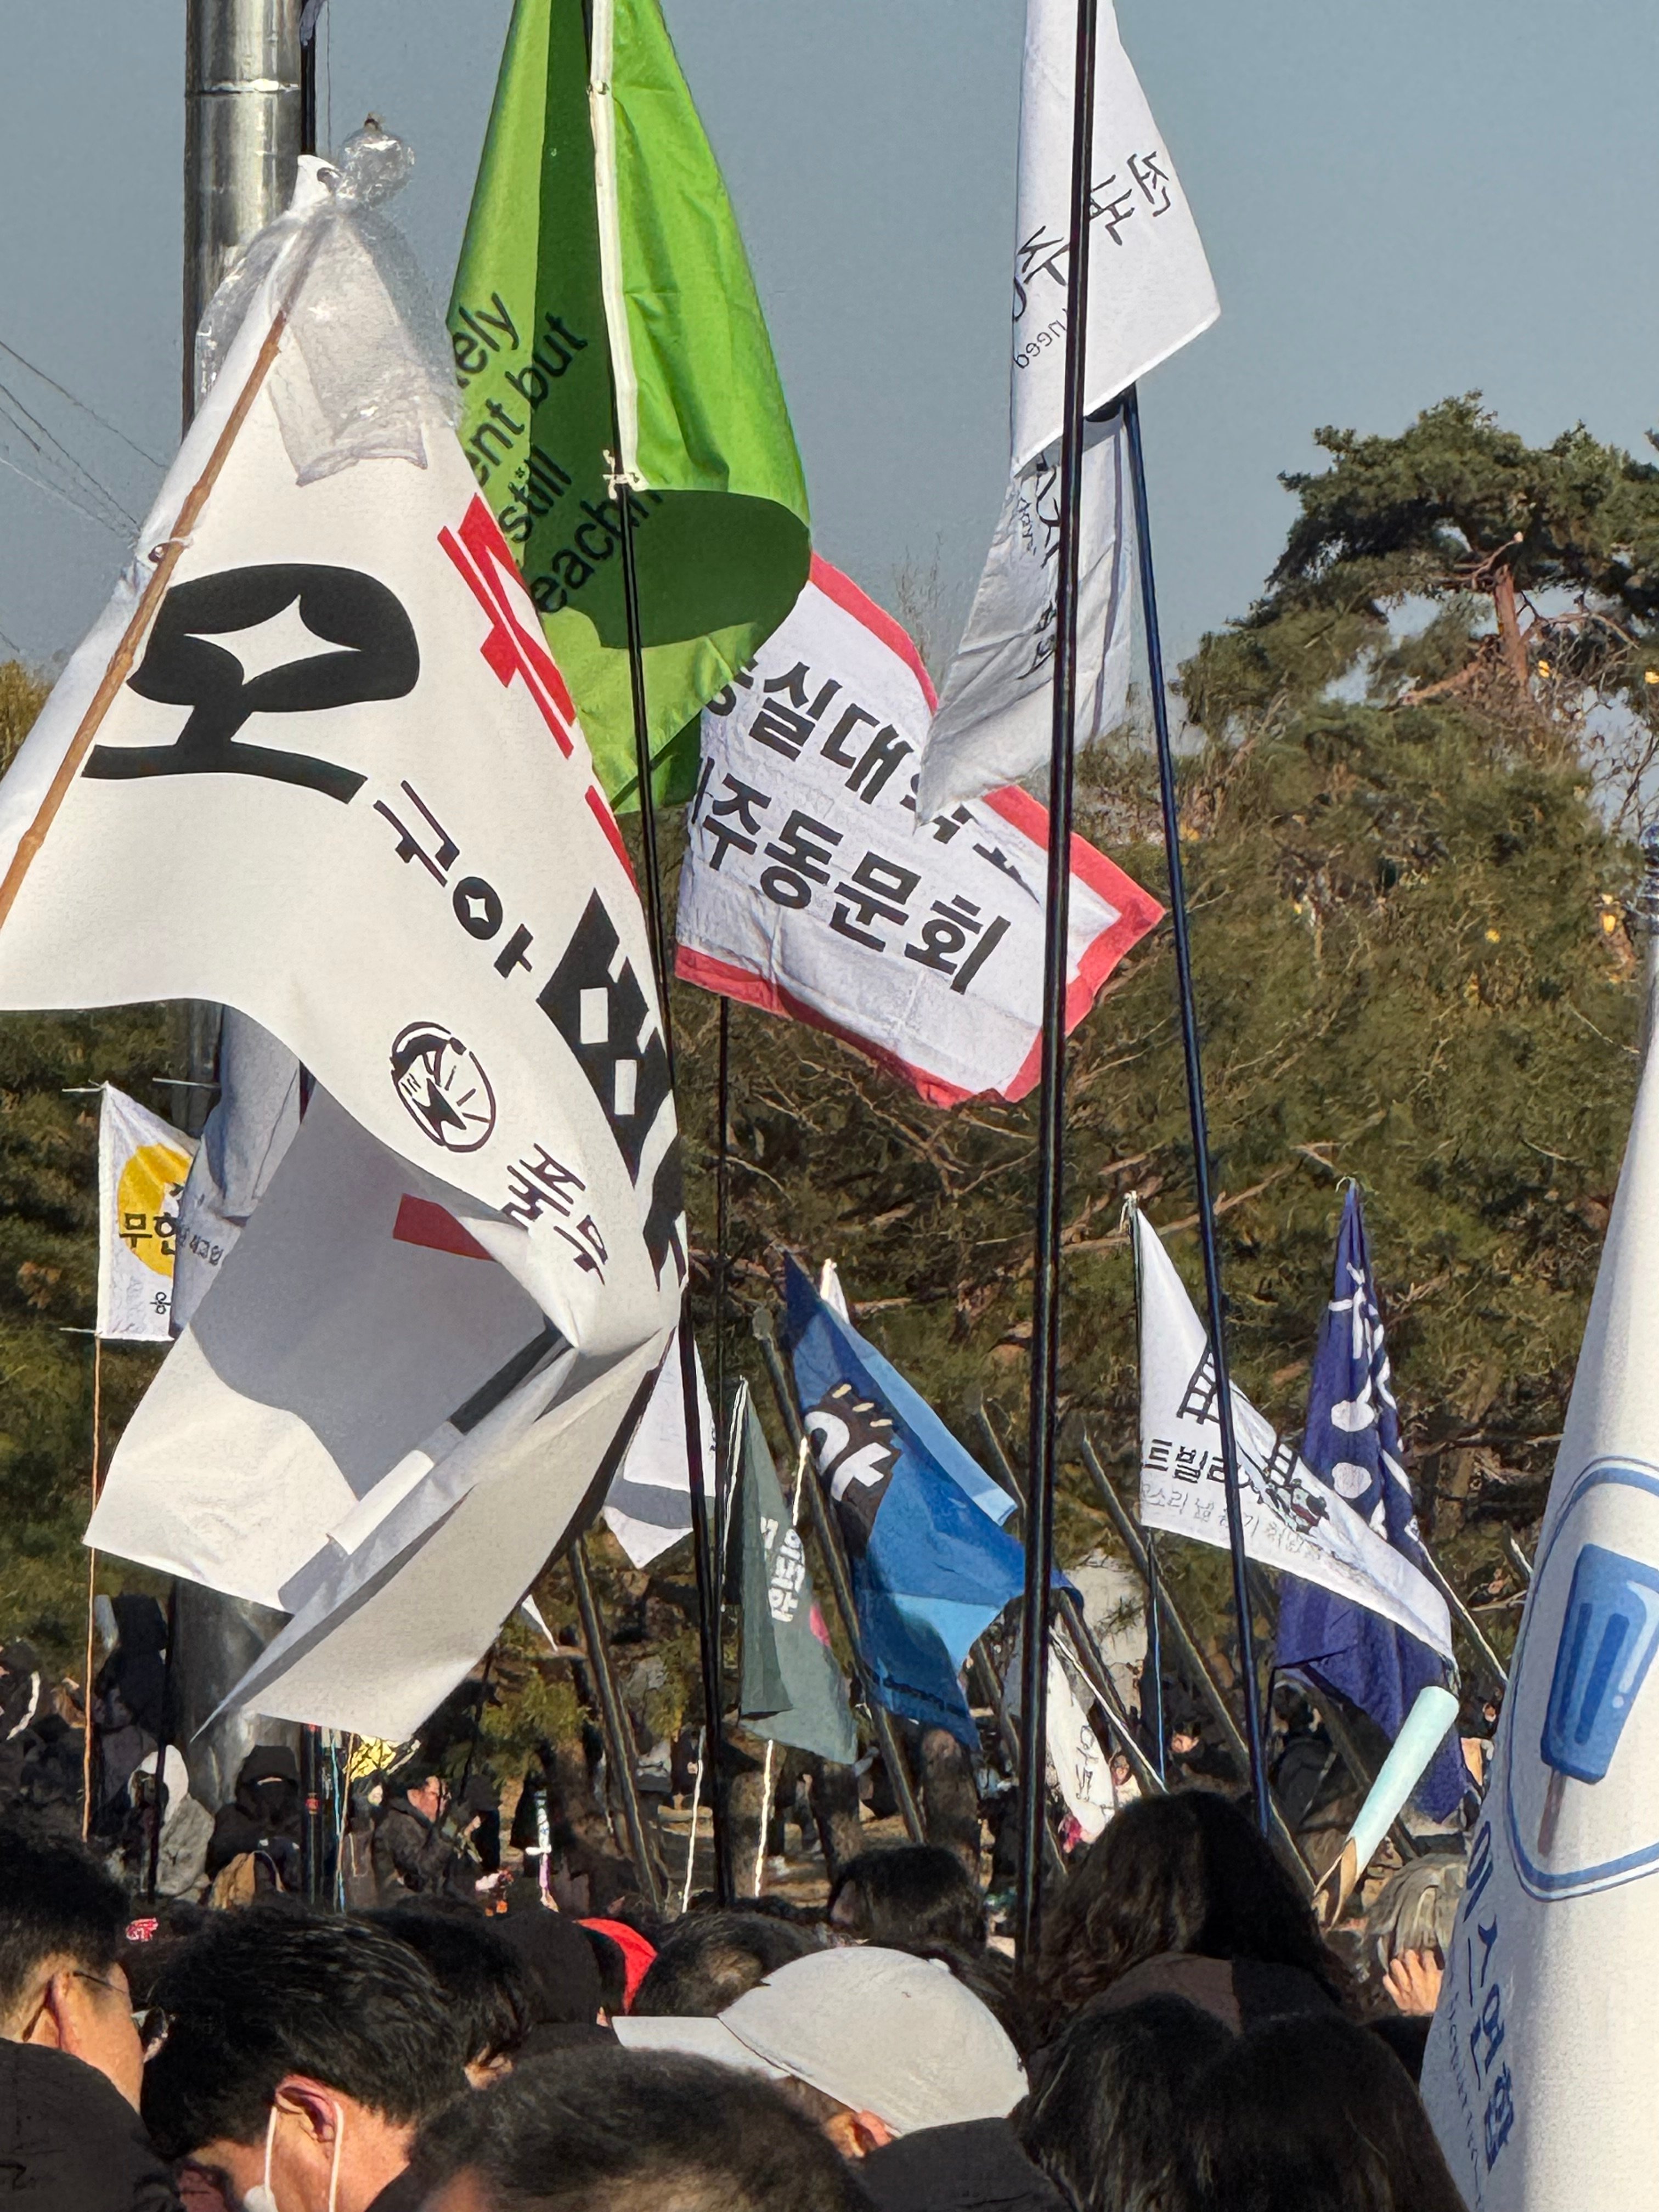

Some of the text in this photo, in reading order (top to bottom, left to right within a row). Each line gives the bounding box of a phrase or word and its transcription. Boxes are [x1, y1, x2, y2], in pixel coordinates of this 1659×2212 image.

[453, 292, 520, 389] ely
[505, 311, 588, 410] but
[499, 444, 572, 543] still
